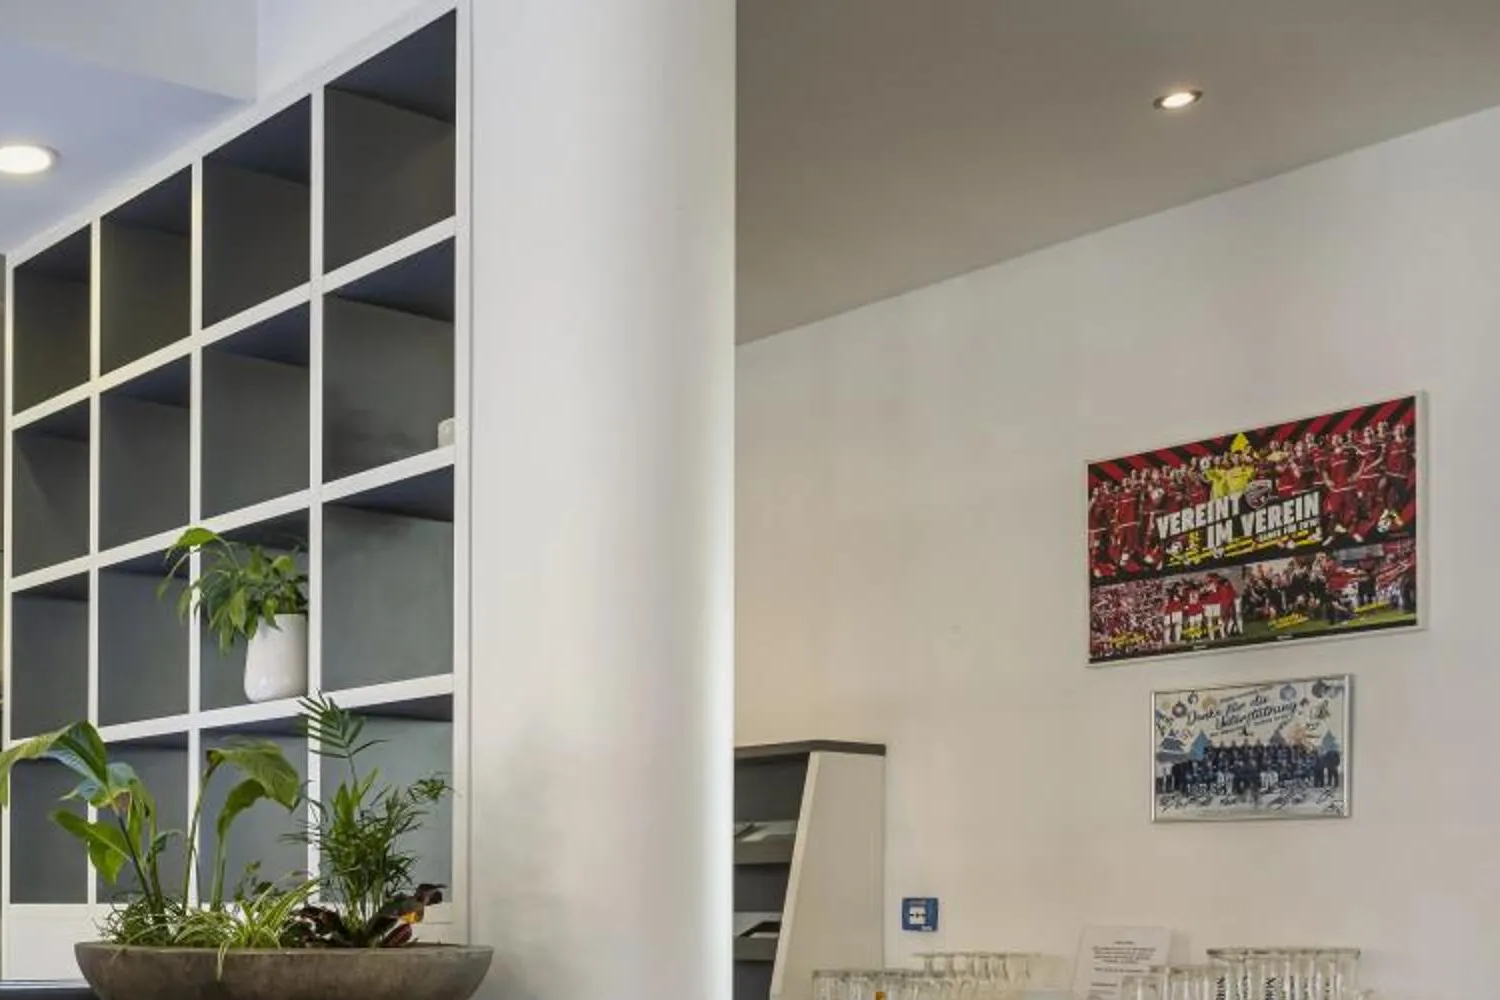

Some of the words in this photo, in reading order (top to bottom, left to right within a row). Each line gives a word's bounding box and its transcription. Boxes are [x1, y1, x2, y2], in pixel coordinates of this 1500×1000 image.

[1156, 491, 1243, 539] VEREINT
[1207, 519, 1234, 548] IM
[1240, 491, 1320, 537] VEREIN
